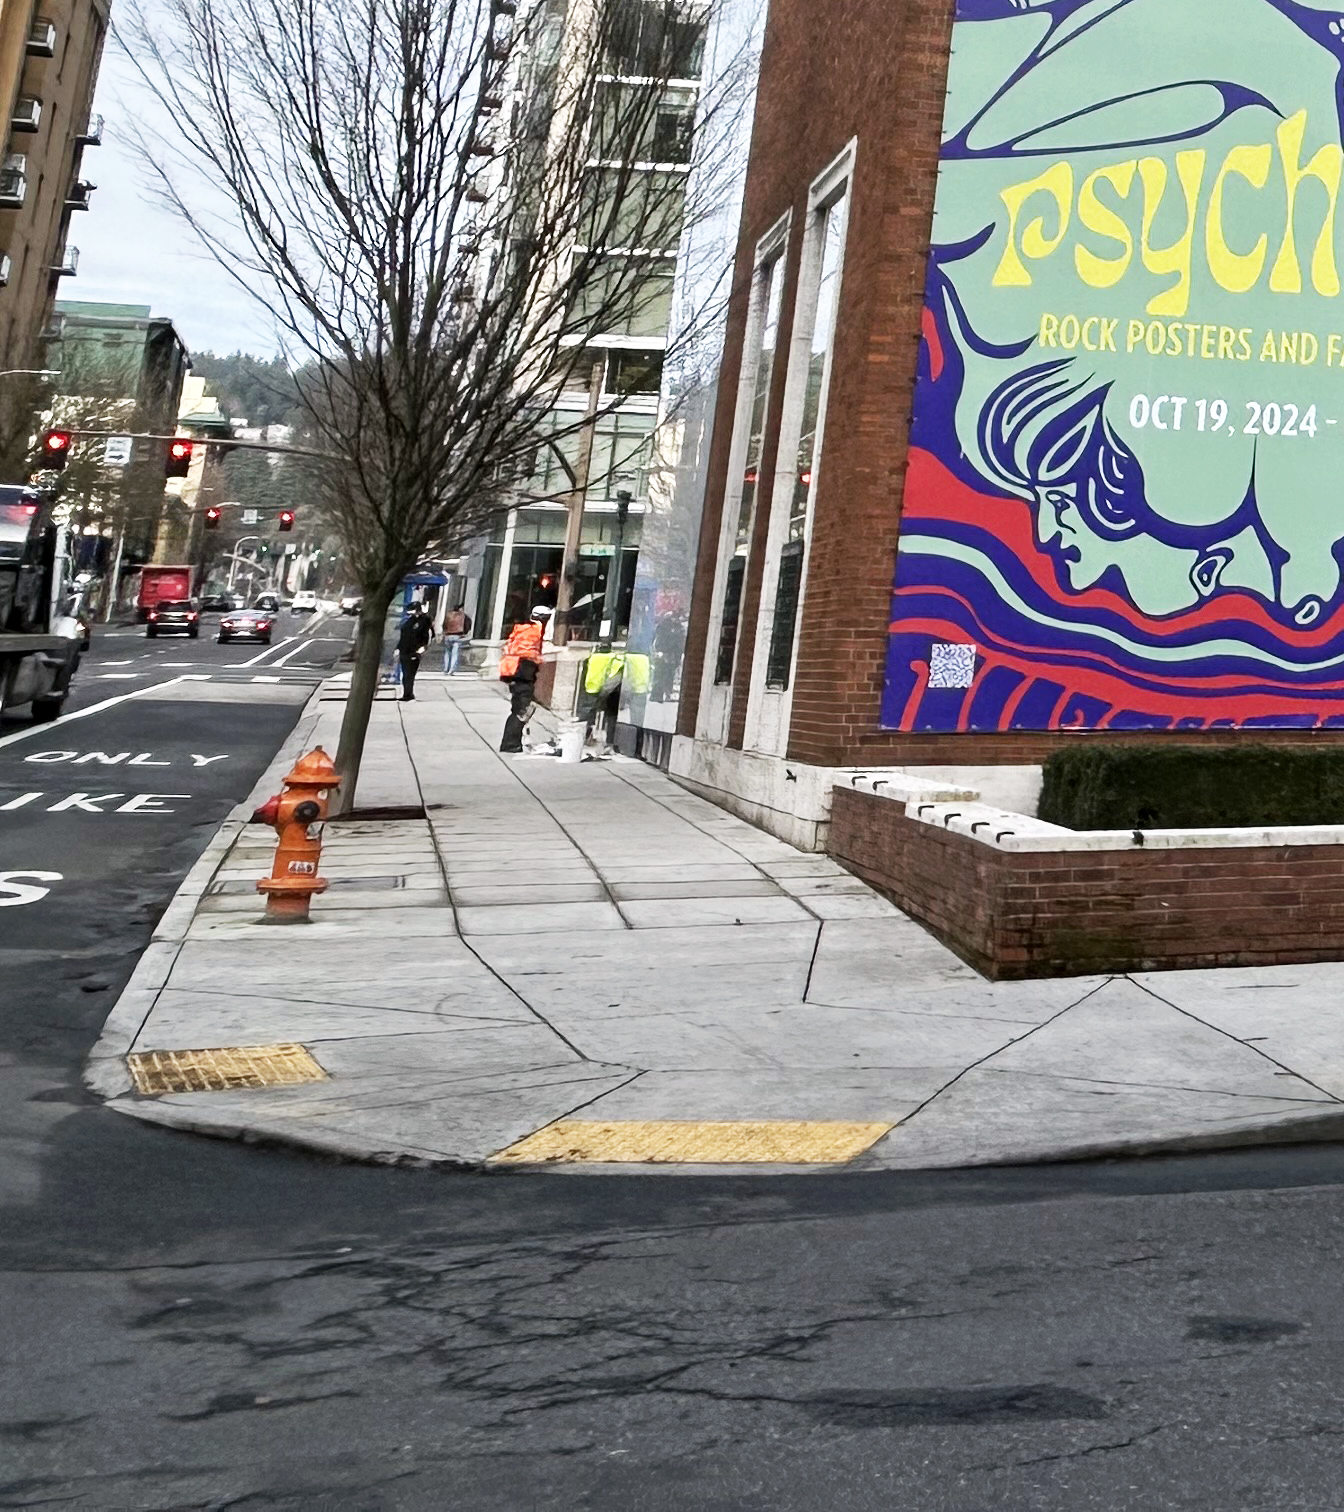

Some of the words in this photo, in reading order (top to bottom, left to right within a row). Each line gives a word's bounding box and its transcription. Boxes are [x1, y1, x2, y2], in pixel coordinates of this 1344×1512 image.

[1037, 312, 1120, 353] ROCK
[1126, 320, 1253, 361] POSTERS
[1259, 329, 1319, 366] AND
[1128, 393, 1187, 431] OCT
[1194, 398, 1235, 437] 19,
[1242, 401, 1318, 438] 2024
[23, 751, 230, 767] ONLY
